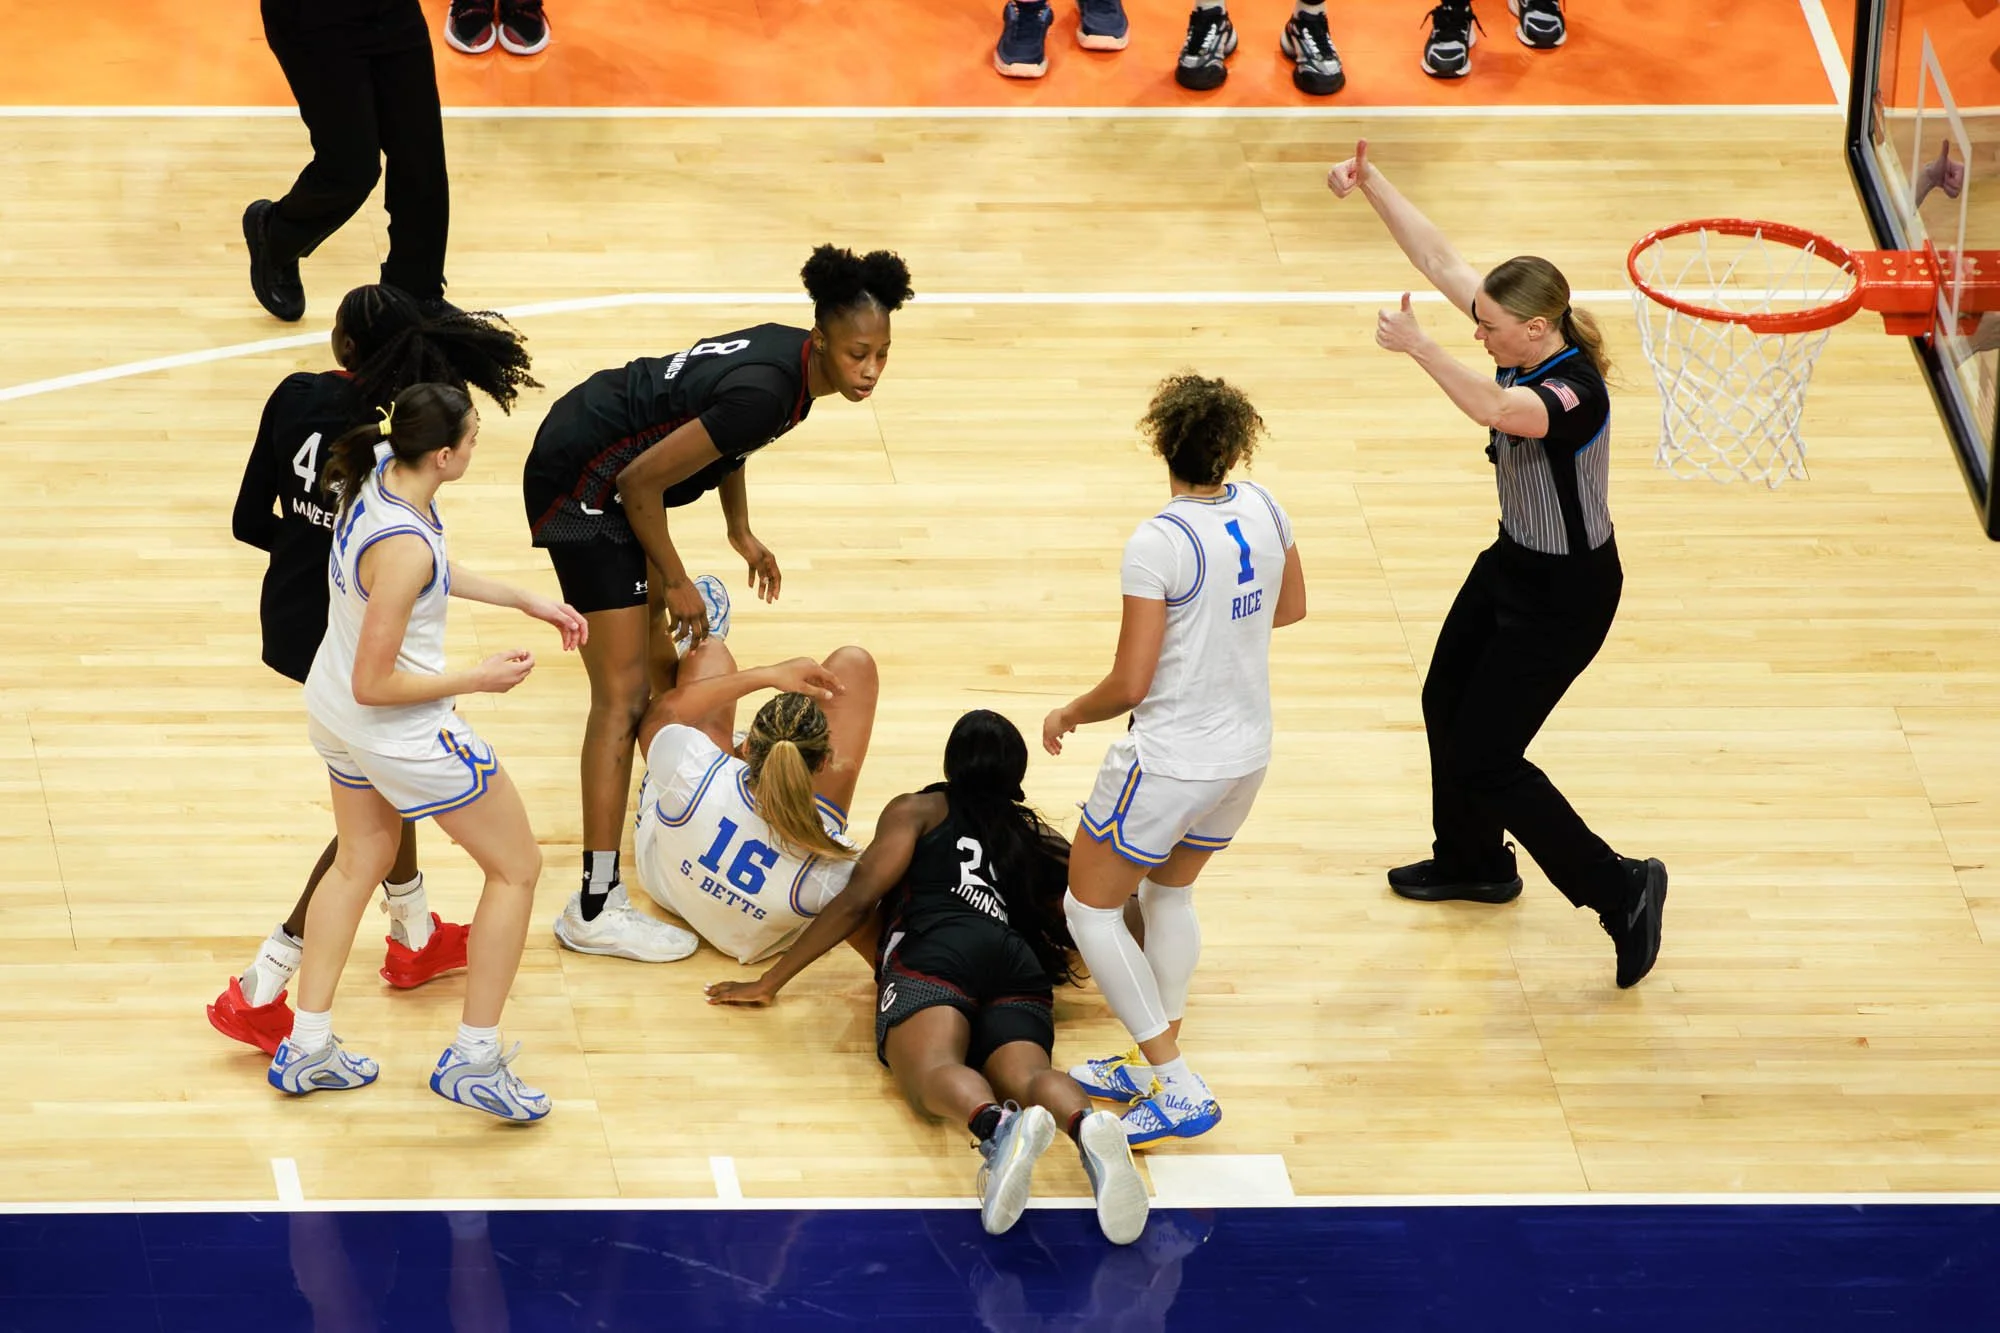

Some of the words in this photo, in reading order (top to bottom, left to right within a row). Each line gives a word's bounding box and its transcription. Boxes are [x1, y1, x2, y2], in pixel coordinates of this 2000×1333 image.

[689, 339, 751, 355] 8
[292, 432, 342, 497] 4
[1224, 518, 1255, 585] 1
[1231, 588, 1263, 620] RICE
[697, 815, 780, 895] 16
[956, 835, 999, 891] 2
[680, 859, 694, 881] S.
[699, 875, 767, 921] BETTS
